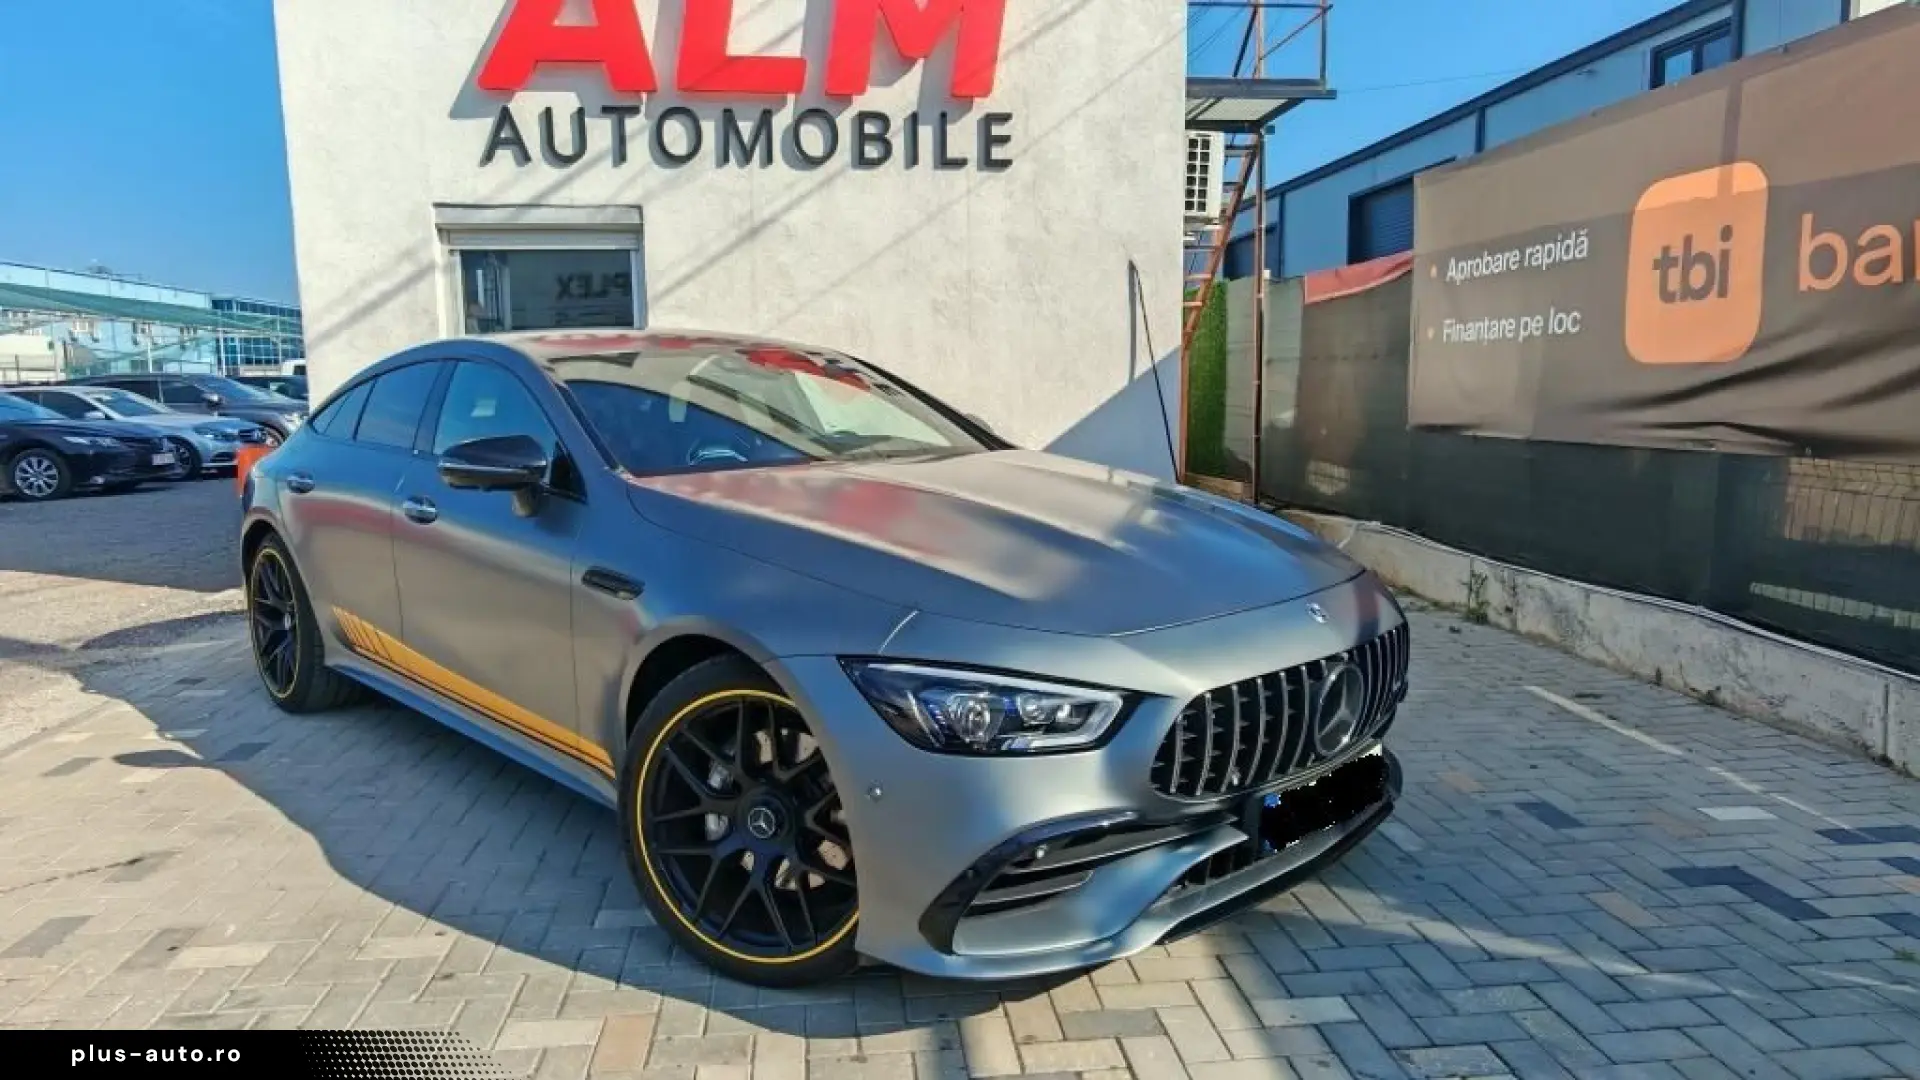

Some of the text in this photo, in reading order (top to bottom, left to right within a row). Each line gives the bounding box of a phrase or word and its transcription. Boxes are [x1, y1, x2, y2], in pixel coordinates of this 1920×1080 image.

[480, 106, 1013, 168] AUTOMOBILE
[1446, 228, 1589, 285] Aprobare rapidă
[1652, 213, 1920, 304] tbi ba
[1442, 306, 1581, 345] Finanțare pe loc
